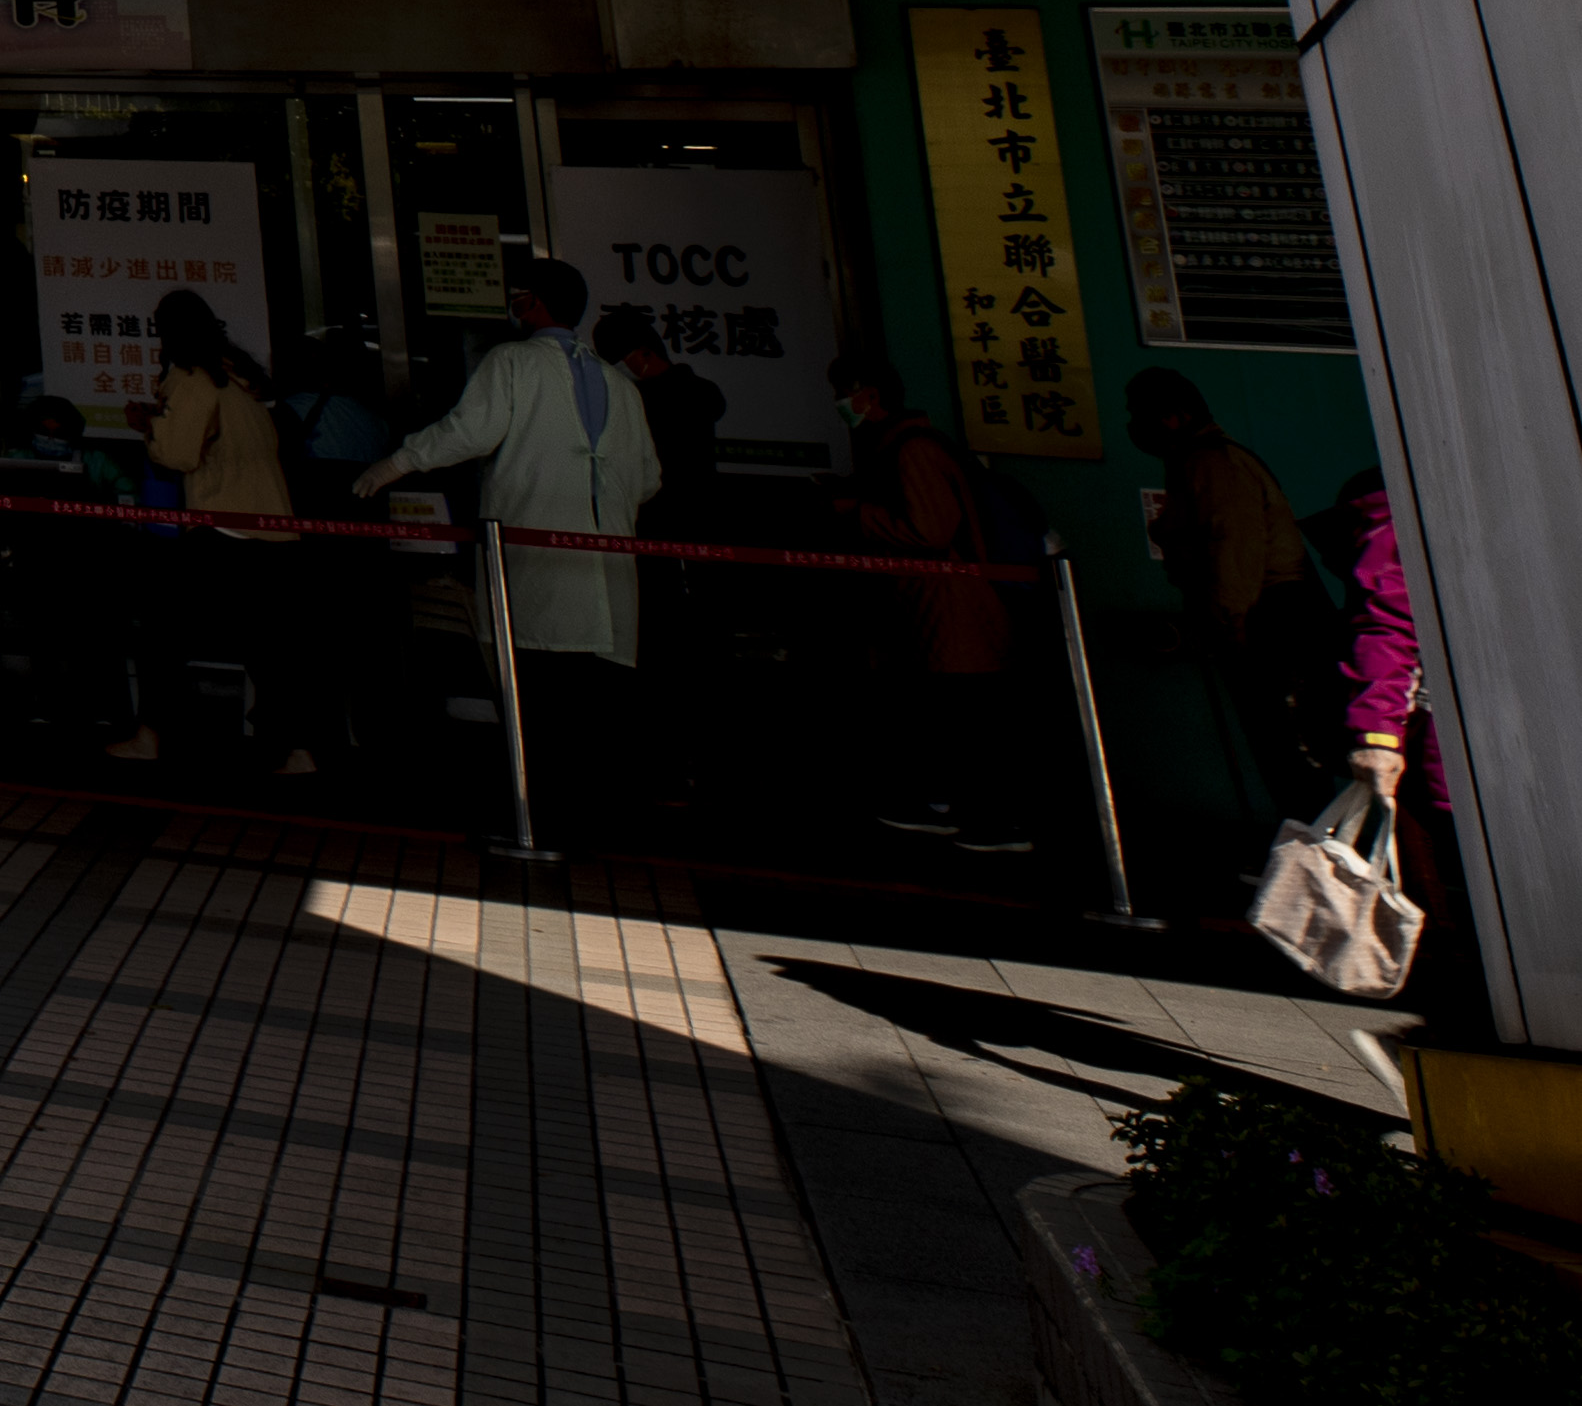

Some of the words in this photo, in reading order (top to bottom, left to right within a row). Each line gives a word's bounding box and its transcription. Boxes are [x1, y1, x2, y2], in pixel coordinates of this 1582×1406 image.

[1220, 39, 1254, 48] CITY
[58, 189, 211, 224] 防疫期間
[974, 28, 1083, 437] 臺北市立聯合醫院
[42, 255, 238, 284] 請減少進出醫院
[612, 243, 749, 287] TOCC
[963, 287, 1010, 426] 和平院區
